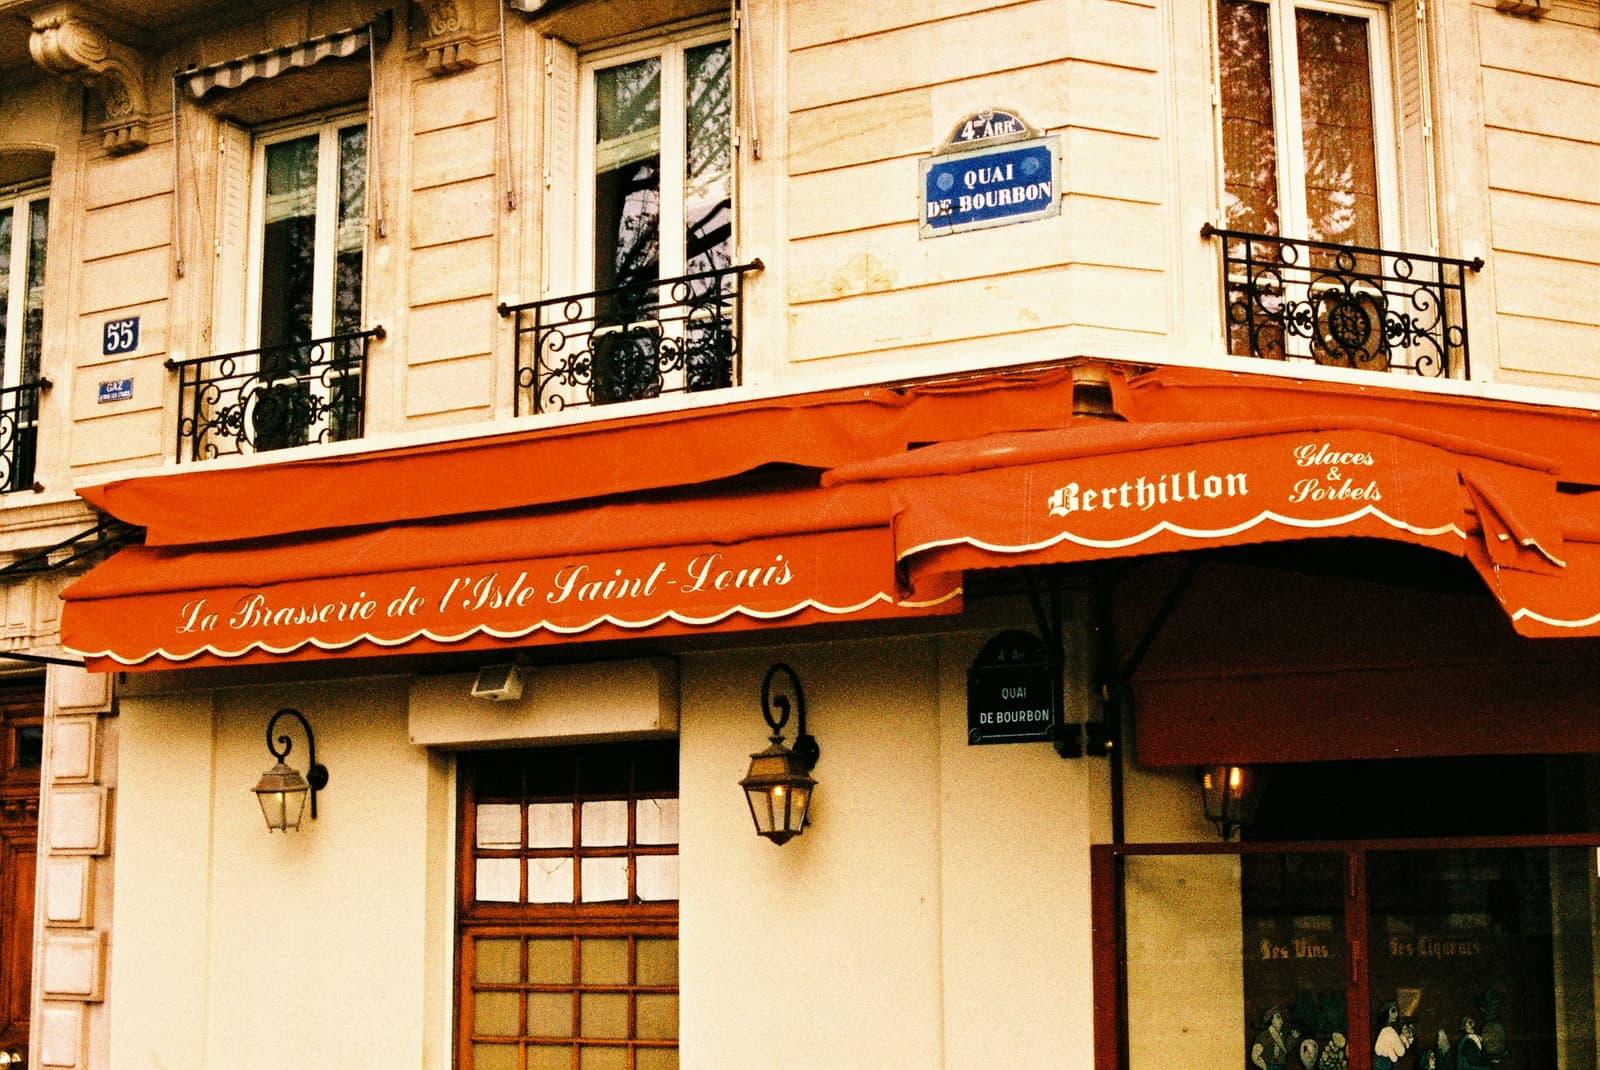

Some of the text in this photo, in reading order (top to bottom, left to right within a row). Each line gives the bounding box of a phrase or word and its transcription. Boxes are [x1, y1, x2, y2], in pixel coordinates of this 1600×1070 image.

[964, 164, 1014, 189] QUAI
[927, 182, 1051, 218] DE BOURBON
[107, 320, 134, 351] 55
[106, 381, 124, 392] GAZ
[1293, 443, 1375, 467] Glaces
[1326, 466, 1342, 480] &
[1048, 470, 1249, 517] Berthillon
[1288, 479, 1383, 503] Sorbets
[176, 599, 218, 634] La
[229, 591, 377, 629] Brasserie
[386, 586, 425, 618] de
[439, 571, 535, 613] l'Isle
[1001, 686, 1027, 700] QUAI
[980, 709, 1050, 724] DE BOURBON
